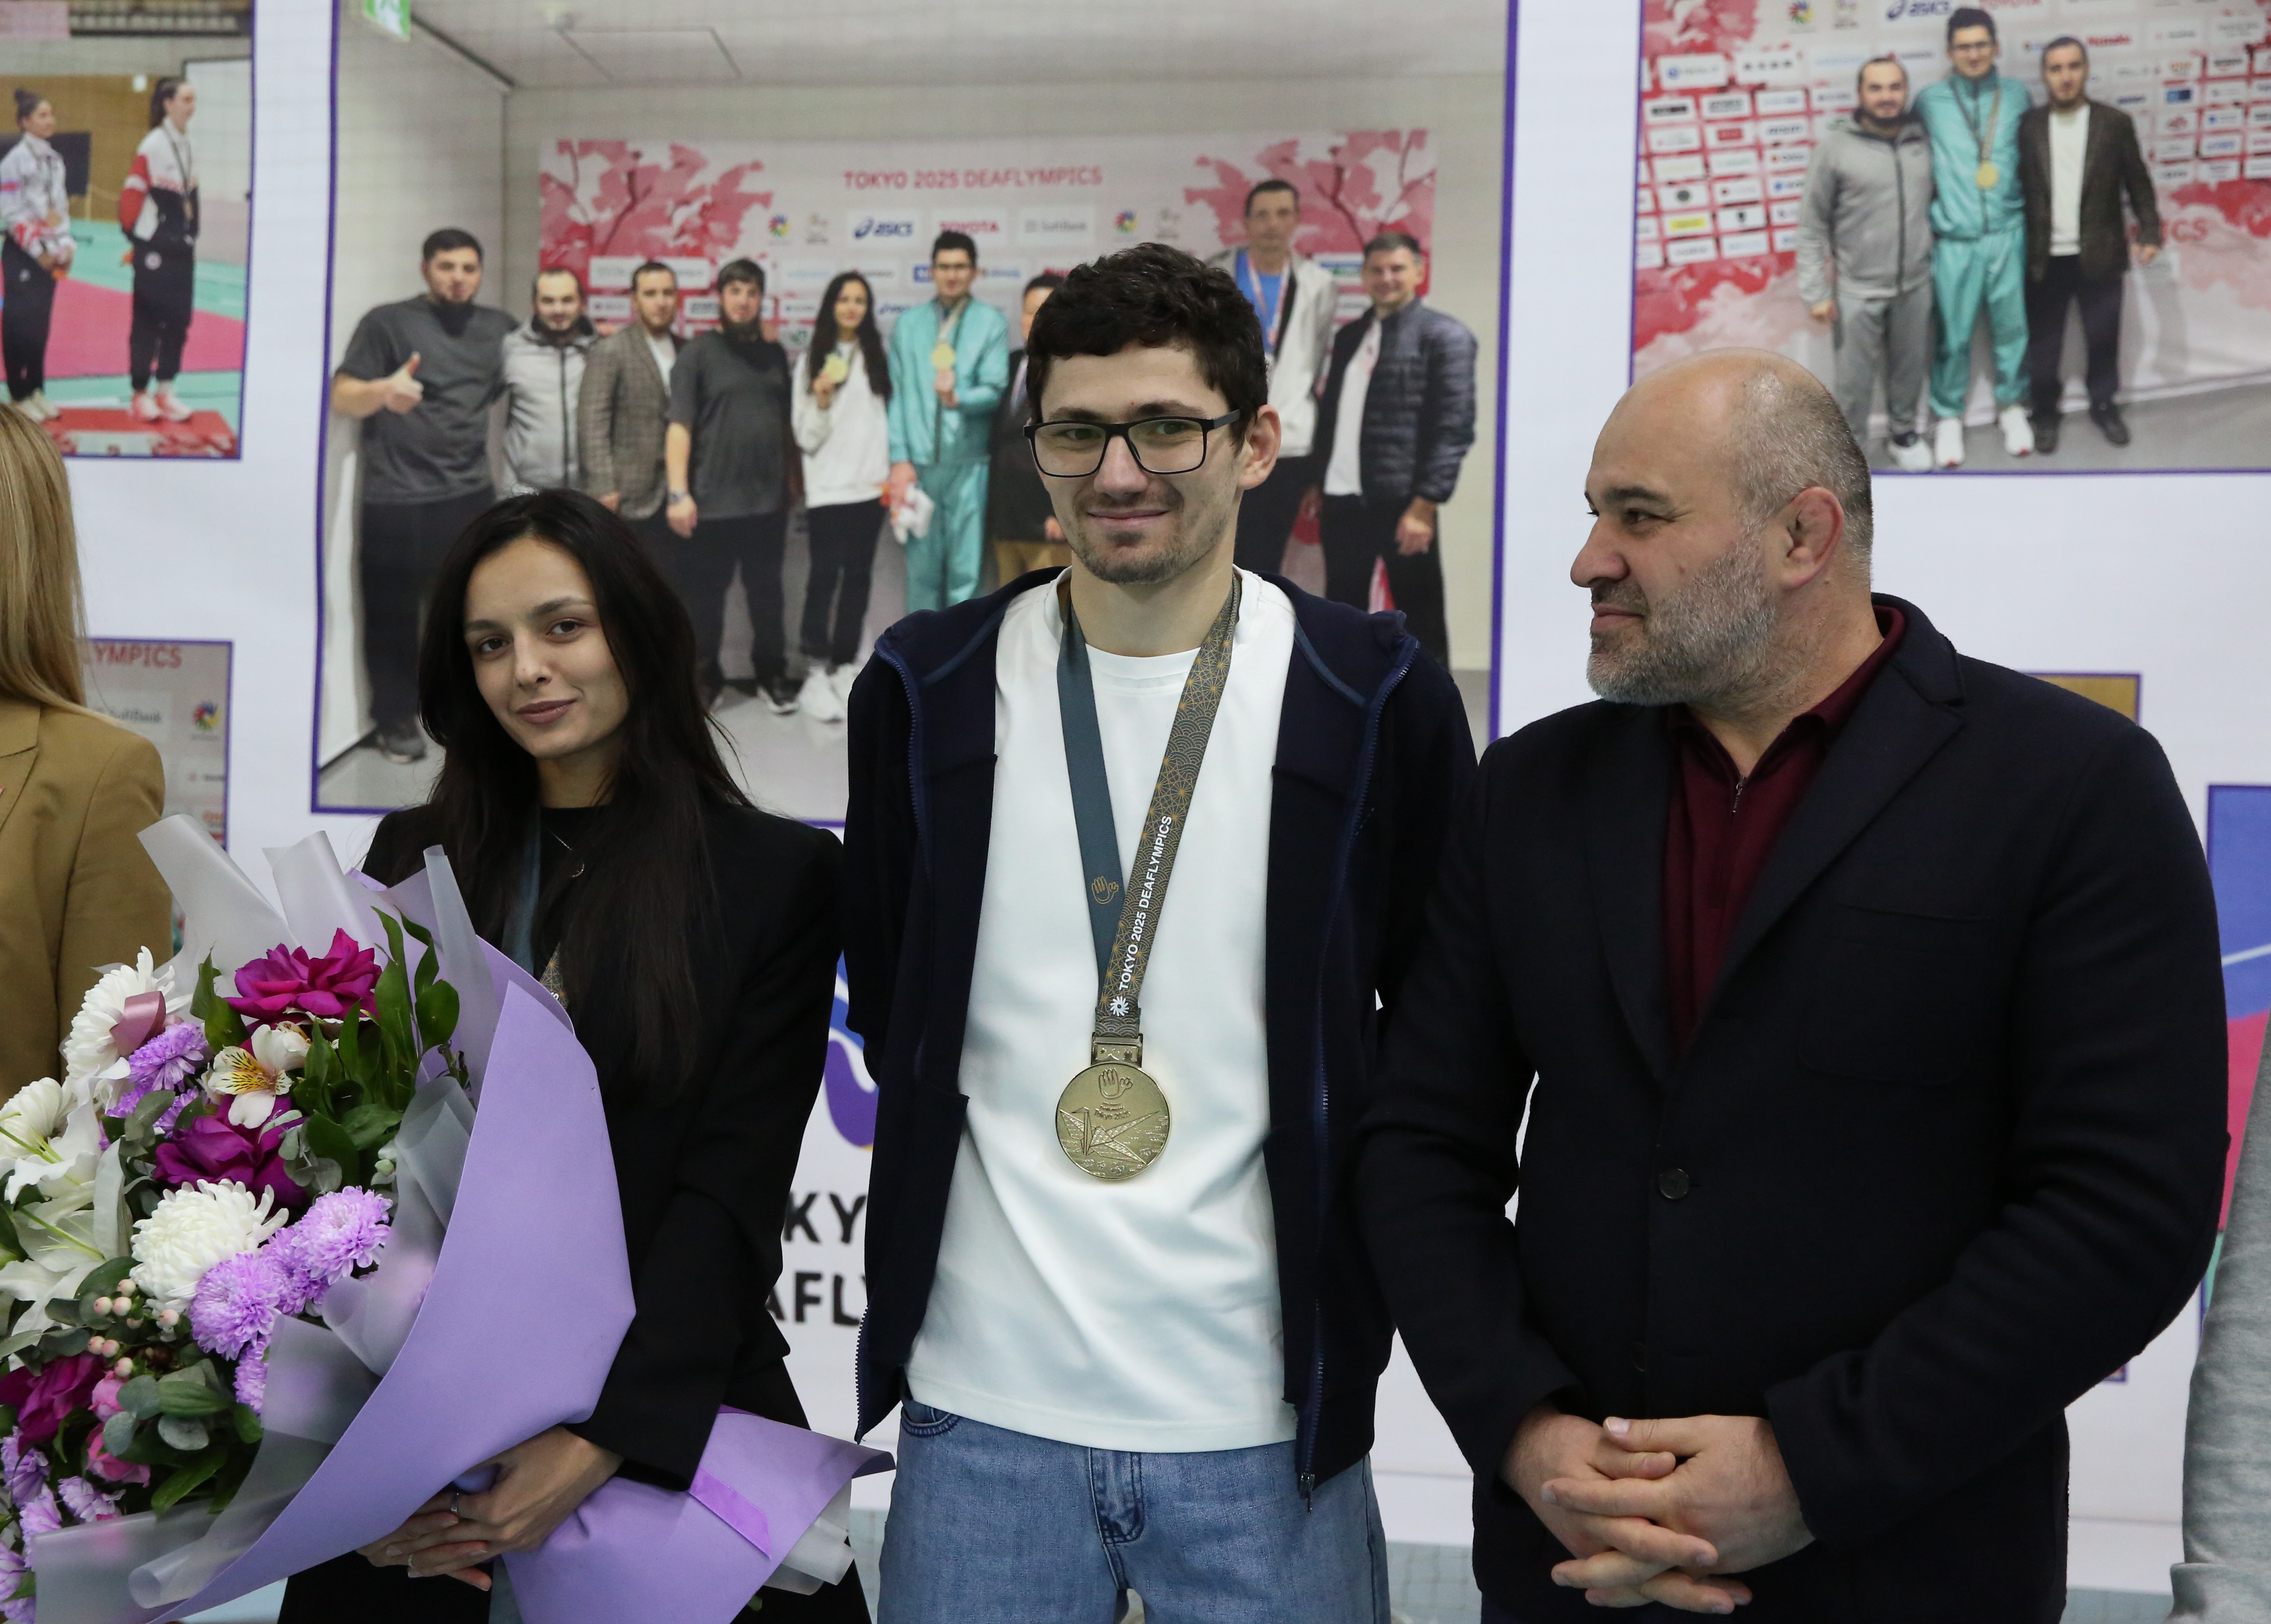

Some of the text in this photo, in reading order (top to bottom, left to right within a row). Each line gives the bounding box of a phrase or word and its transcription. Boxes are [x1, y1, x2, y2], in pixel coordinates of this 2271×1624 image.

[844, 166, 1102, 189] TOKYO 2025 DEAFLYMPICS
[1119, 815, 1172, 991] TOKYO 2025 DEAFLYMPICS
[783, 1192, 866, 1245] KY
